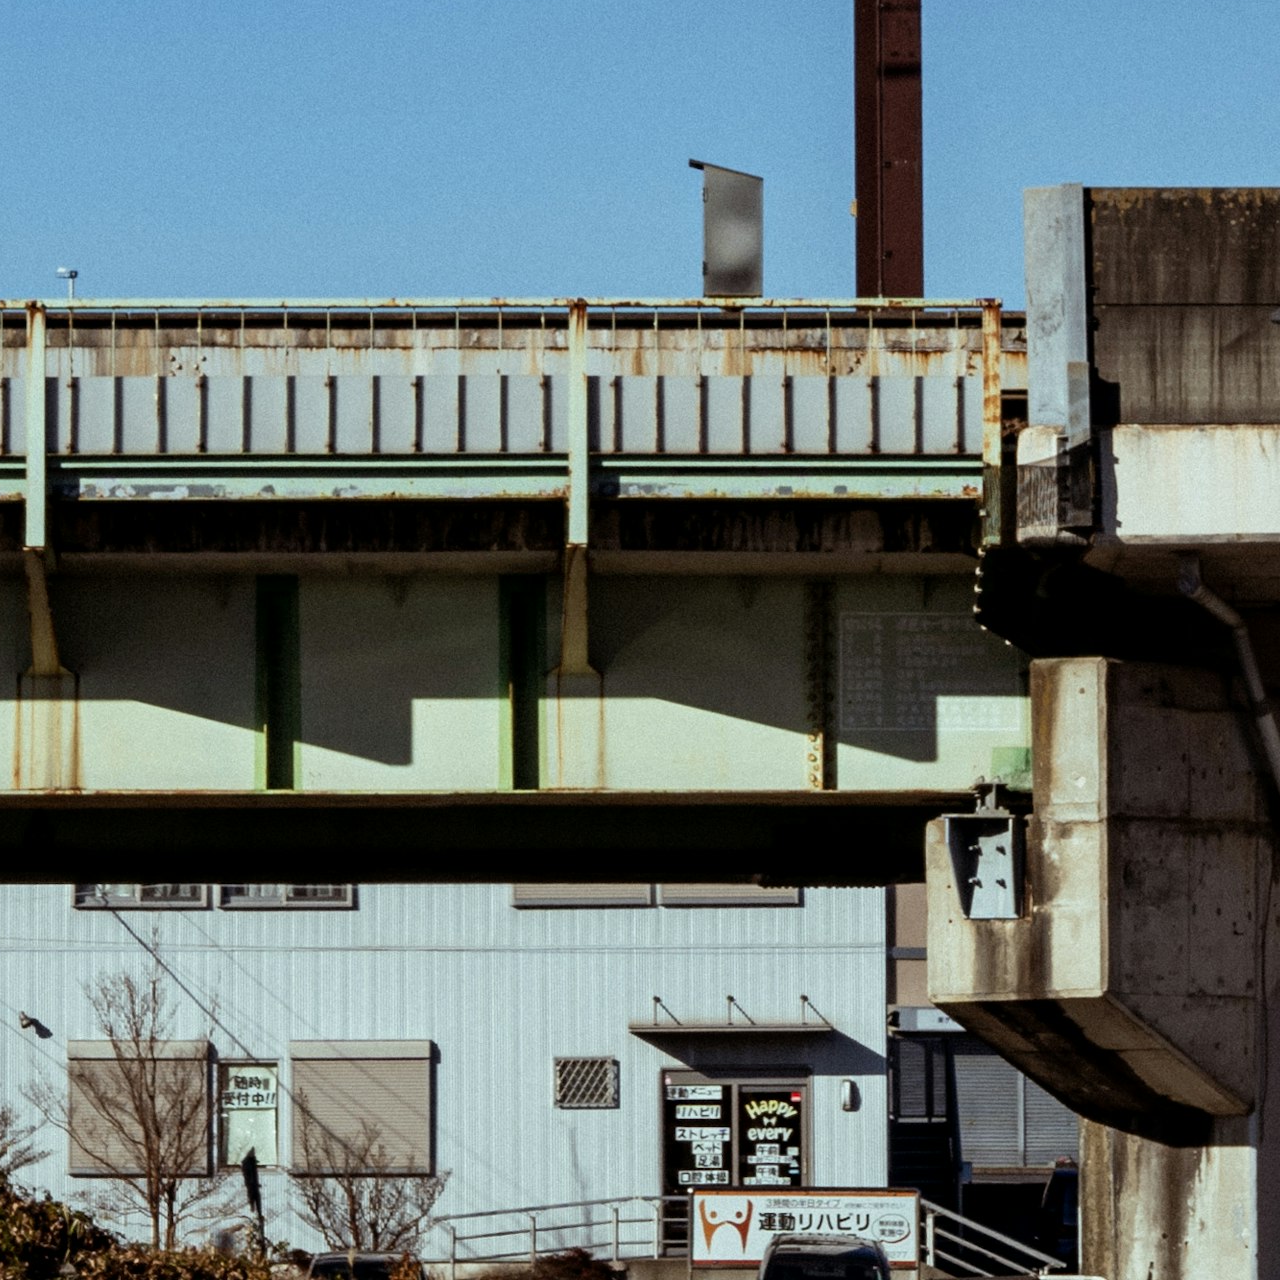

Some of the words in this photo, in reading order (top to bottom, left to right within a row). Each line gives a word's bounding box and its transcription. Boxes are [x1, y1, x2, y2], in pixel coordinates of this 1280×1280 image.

[677, 1107, 720, 1118] リハビリ
[744, 1099, 798, 1120] Happy
[677, 1129, 728, 1140] ストレッチ
[747, 1127, 794, 1142] every
[693, 1142, 721, 1152] ベッド
[758, 1212, 870, 1232] 運動リハビリ
